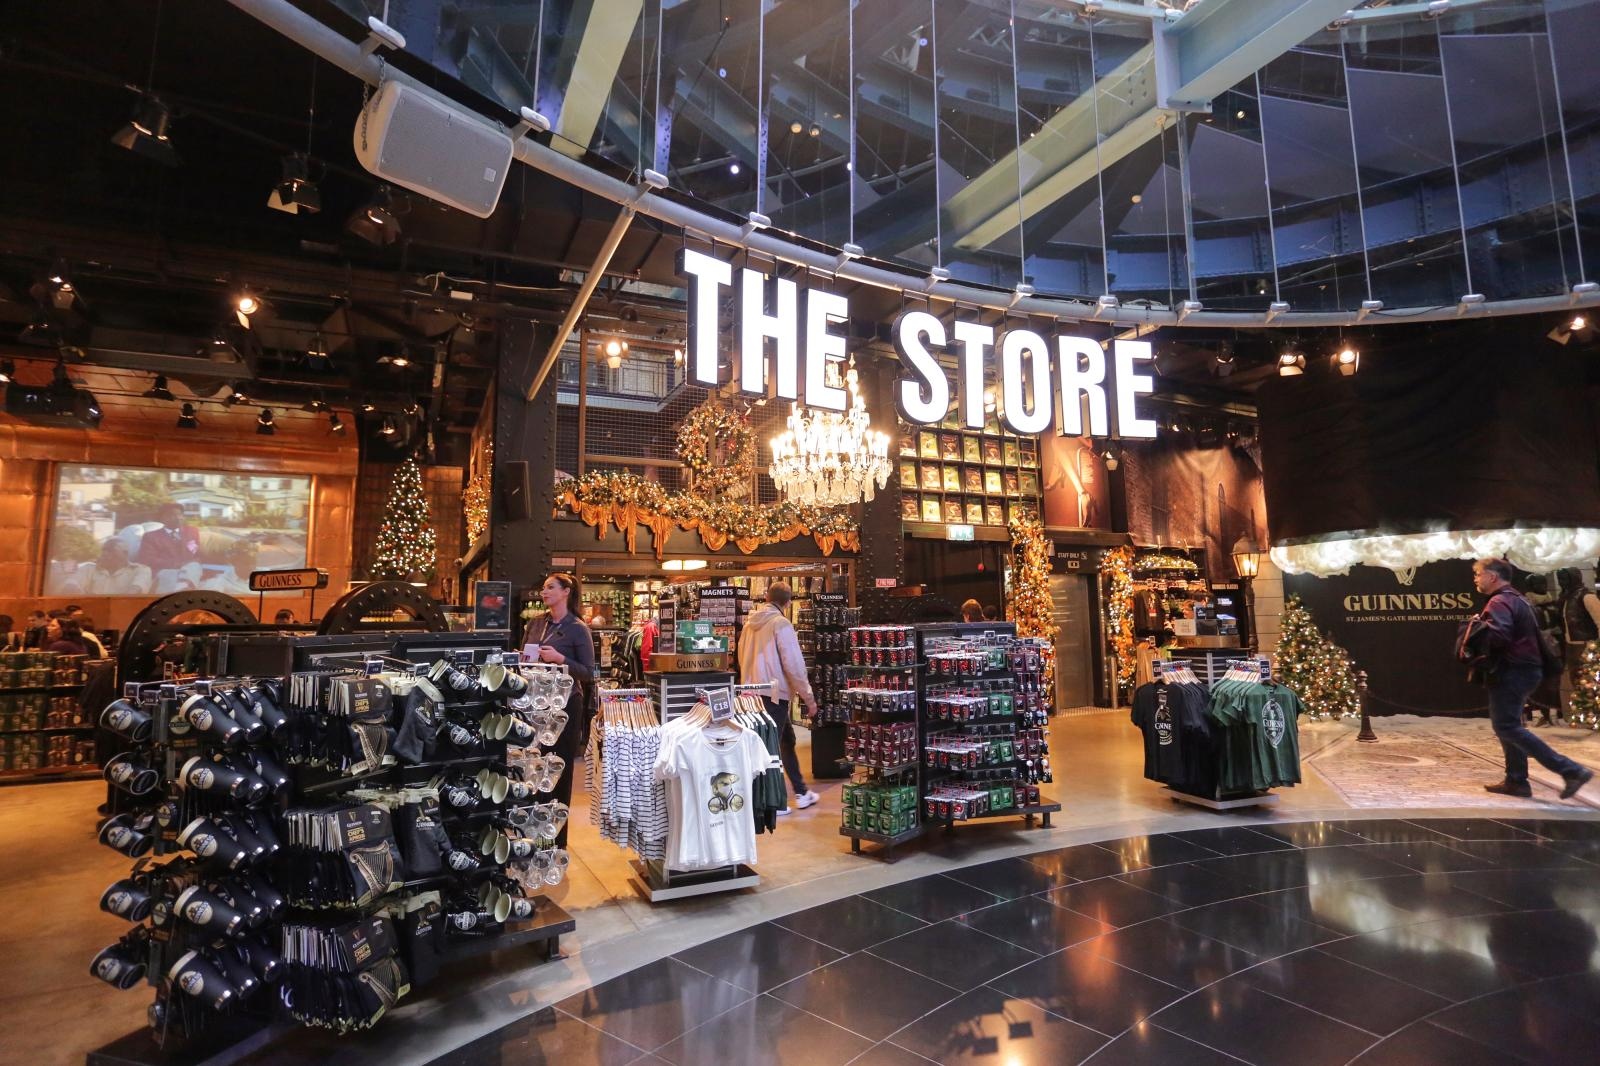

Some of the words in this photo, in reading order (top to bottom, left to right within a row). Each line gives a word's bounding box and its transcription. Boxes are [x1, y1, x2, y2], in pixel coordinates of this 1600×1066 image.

[684, 248, 849, 412] THE
[898, 311, 1158, 439] STORE
[260, 574, 302, 588] GUINNESS
[701, 588, 734, 596] MAGNETS
[1343, 592, 1475, 612] GUINNESS
[1357, 615, 1386, 623] JAMES'S
[1407, 614, 1446, 622] BREWERY,
[676, 659, 715, 669] GUINNESS
[713, 701, 729, 711] €18
